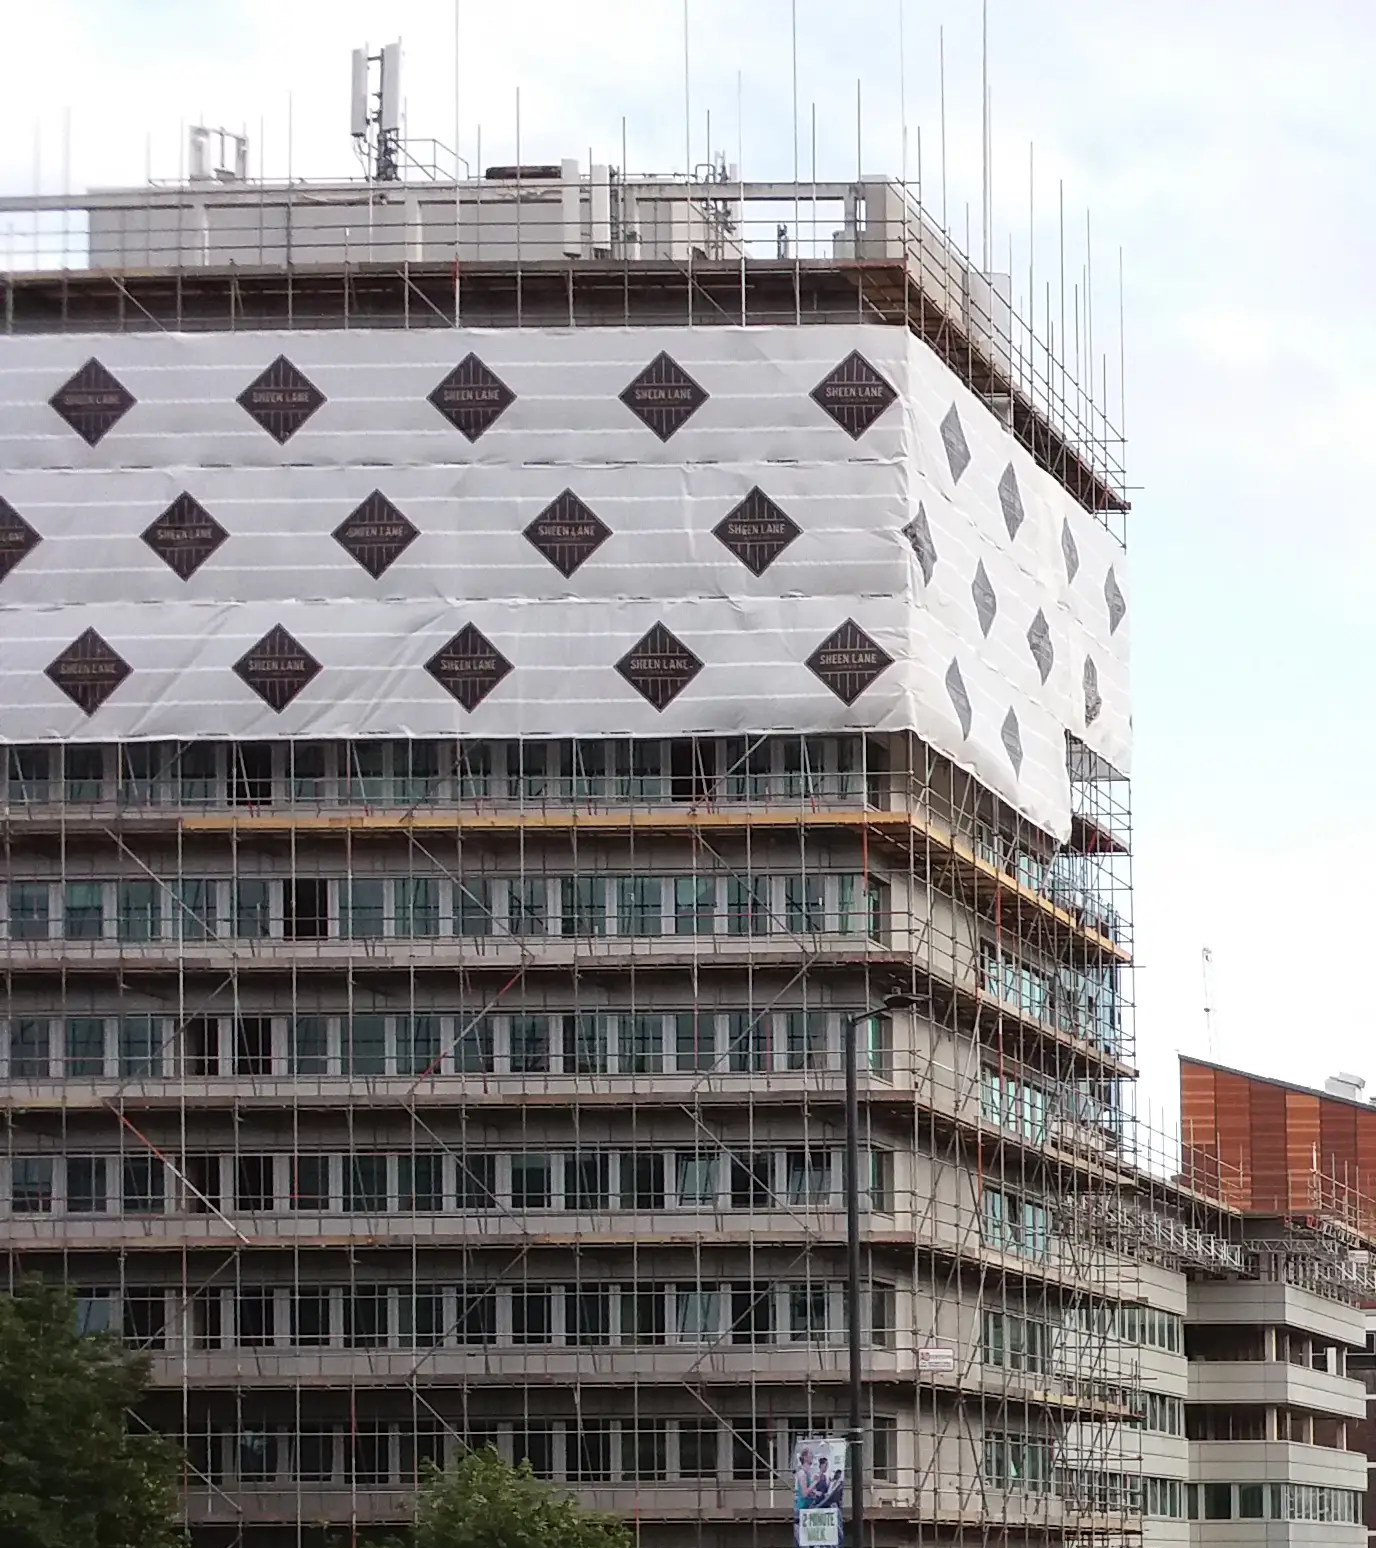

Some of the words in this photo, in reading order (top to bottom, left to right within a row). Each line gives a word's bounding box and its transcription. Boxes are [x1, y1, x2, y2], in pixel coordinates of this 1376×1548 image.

[636, 388, 666, 399] SHEEN
[668, 388, 692, 399] LANE
[826, 387, 856, 397] SHEEN
[859, 387, 883, 397] LANE
[571, 526, 595, 536] LANE
[761, 524, 785, 535] LANE
[663, 659, 688, 670] LANE
[820, 654, 850, 665] SHEEN
[852, 654, 877, 665] LANE
